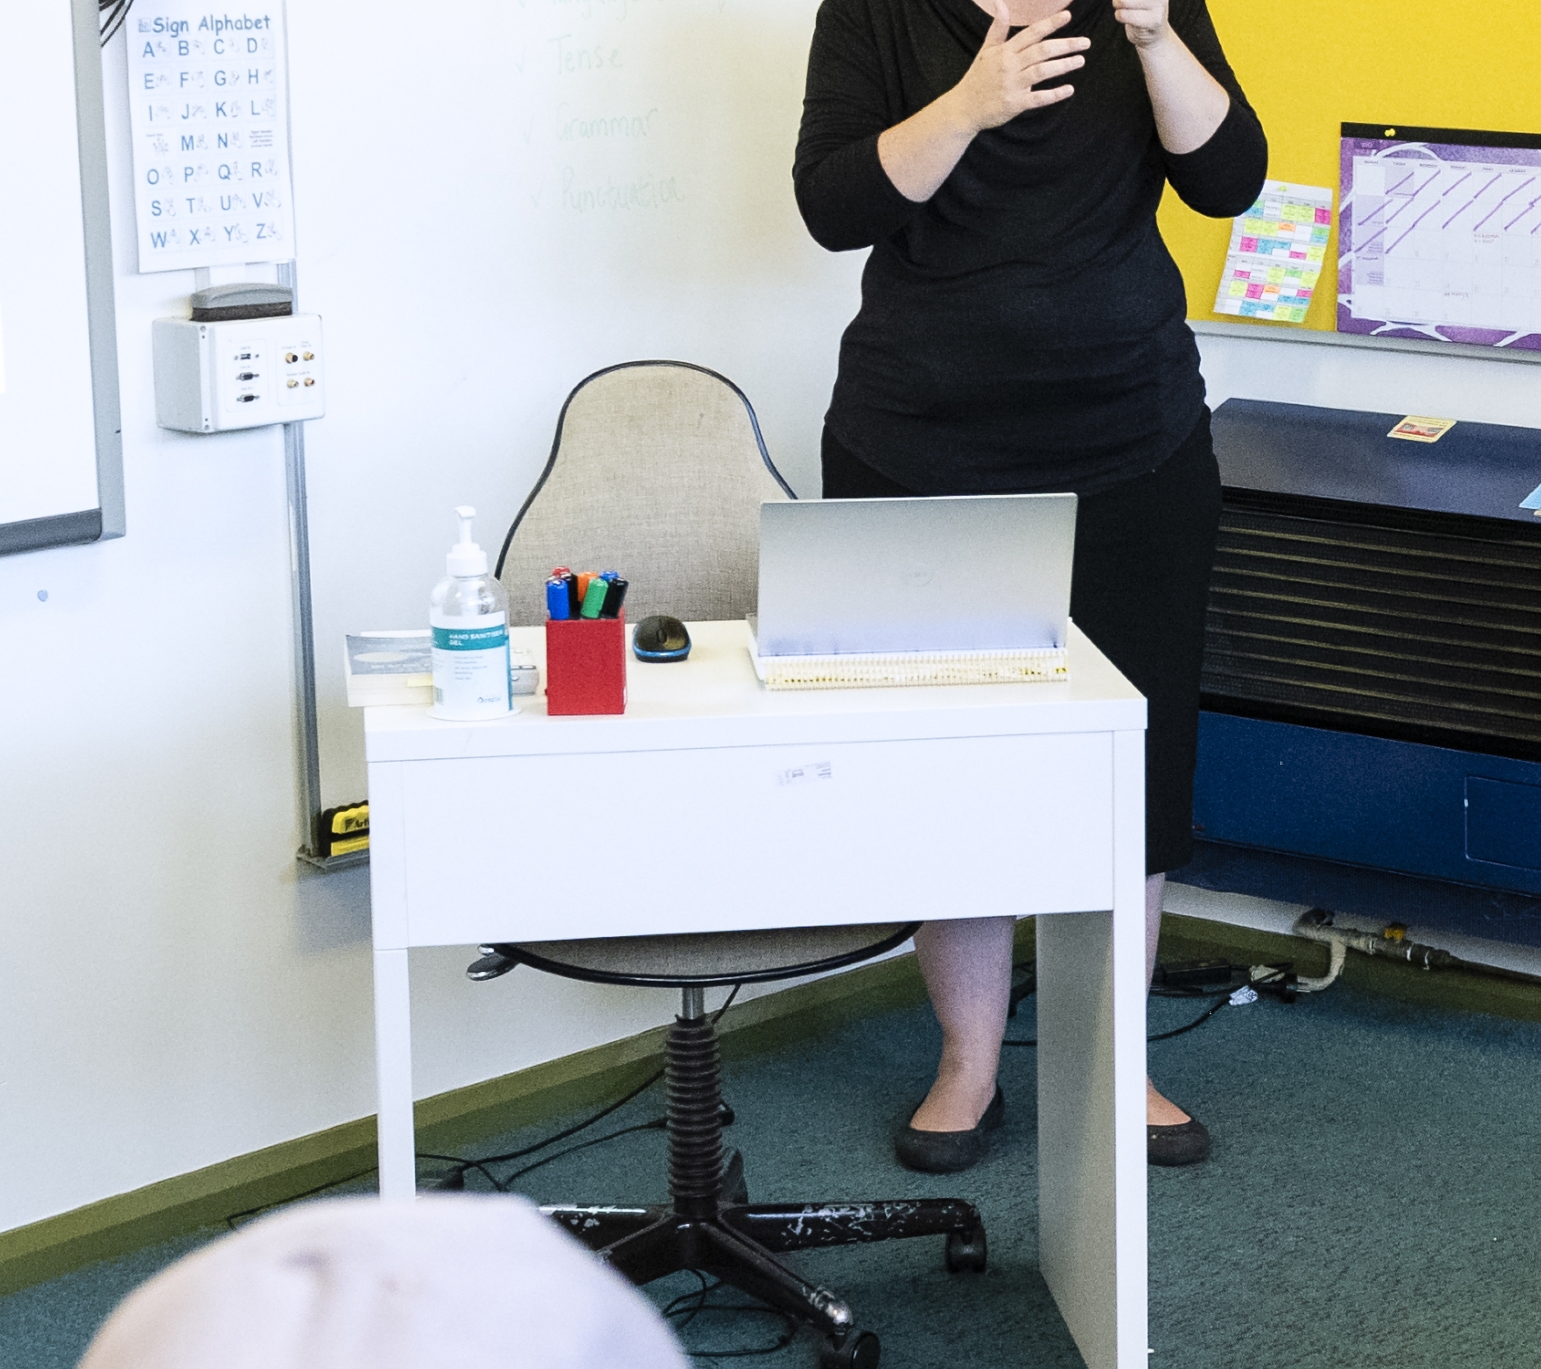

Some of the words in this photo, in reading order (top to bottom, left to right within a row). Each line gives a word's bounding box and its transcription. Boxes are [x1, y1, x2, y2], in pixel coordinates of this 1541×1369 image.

[152, 16, 189, 38] Sign
[197, 14, 271, 36] Alphabet
[142, 41, 156, 58] A
[178, 40, 189, 56] B
[213, 38, 225, 55] C
[247, 37, 258, 54] D
[548, 32, 625, 75] Tense
[144, 73, 155, 90] E
[180, 72, 189, 88] F
[214, 70, 227, 86] G
[248, 68, 259, 85] H
[148, 104, 153, 121] I
[181, 103, 190, 119] J
[215, 101, 227, 118] K
[251, 100, 260, 116] L
[181, 134, 195, 151] M
[217, 132, 228, 148] N
[146, 168, 160, 185] O
[184, 166, 195, 183] P
[218, 163, 231, 180] Q
[251, 161, 263, 178] R
[151, 200, 162, 217] S
[186, 198, 196, 214] T
[220, 194, 231, 211] U
[252, 192, 263, 209] V
[150, 231, 167, 249] W
[189, 229, 200, 245] X
[223, 225, 235, 242] Y
[256, 223, 267, 240] Z
[449, 632, 469, 640] HAND
